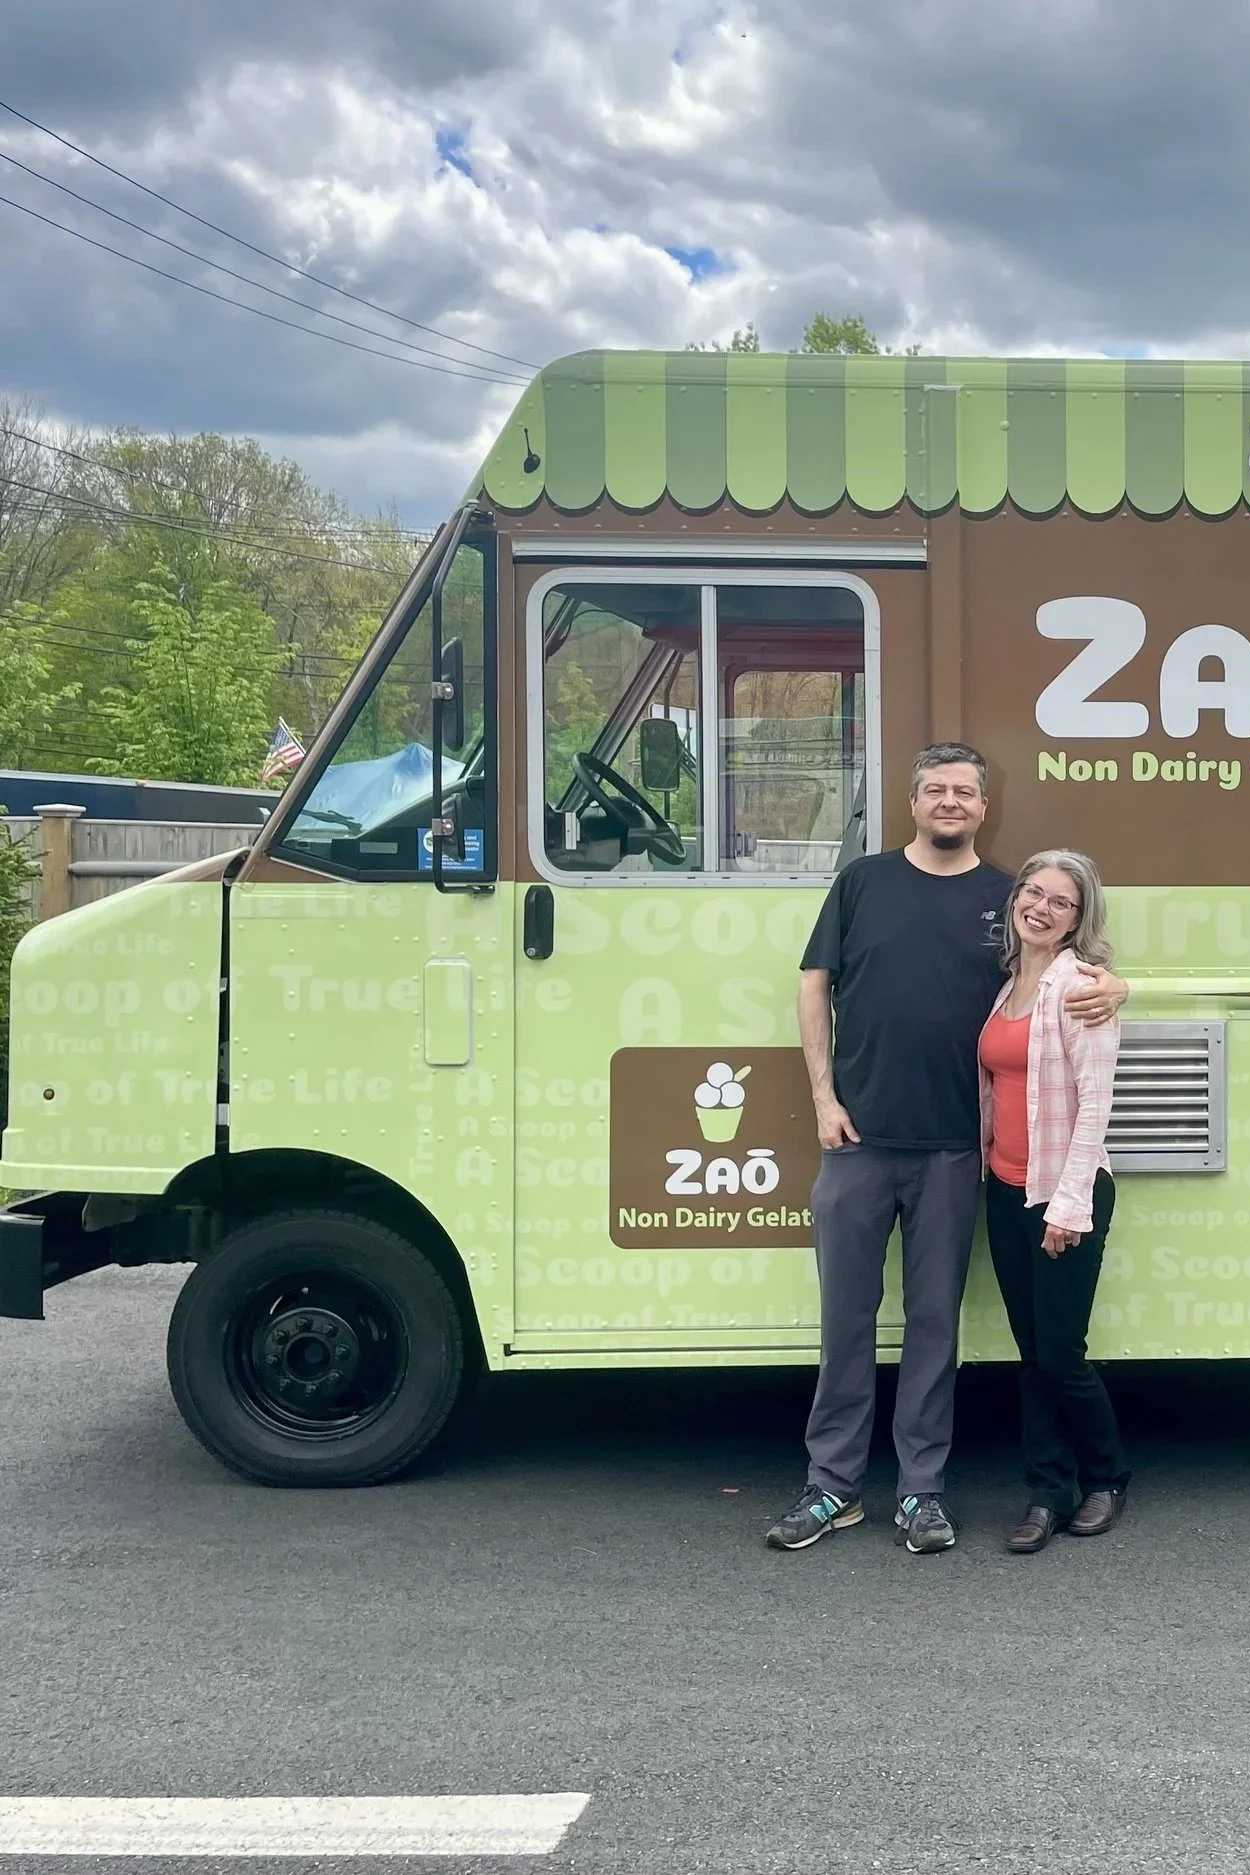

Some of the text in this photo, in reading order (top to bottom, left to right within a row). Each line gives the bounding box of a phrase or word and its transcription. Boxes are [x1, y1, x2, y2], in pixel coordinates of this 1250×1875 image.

[1038, 751, 1118, 782] Non
[1132, 751, 1242, 790] Dairy
[268, 964, 421, 1012] True
[294, 1067, 393, 1103] Life
[455, 1065, 494, 1107] A
[455, 1146, 494, 1187] A
[619, 1206, 814, 1233] Non Dairy Gelat
[1131, 1204, 1224, 1231] Scoop
[507, 1245, 691, 1298] Scoop
[709, 1248, 772, 1286] of
[1094, 1293, 1148, 1328] of
